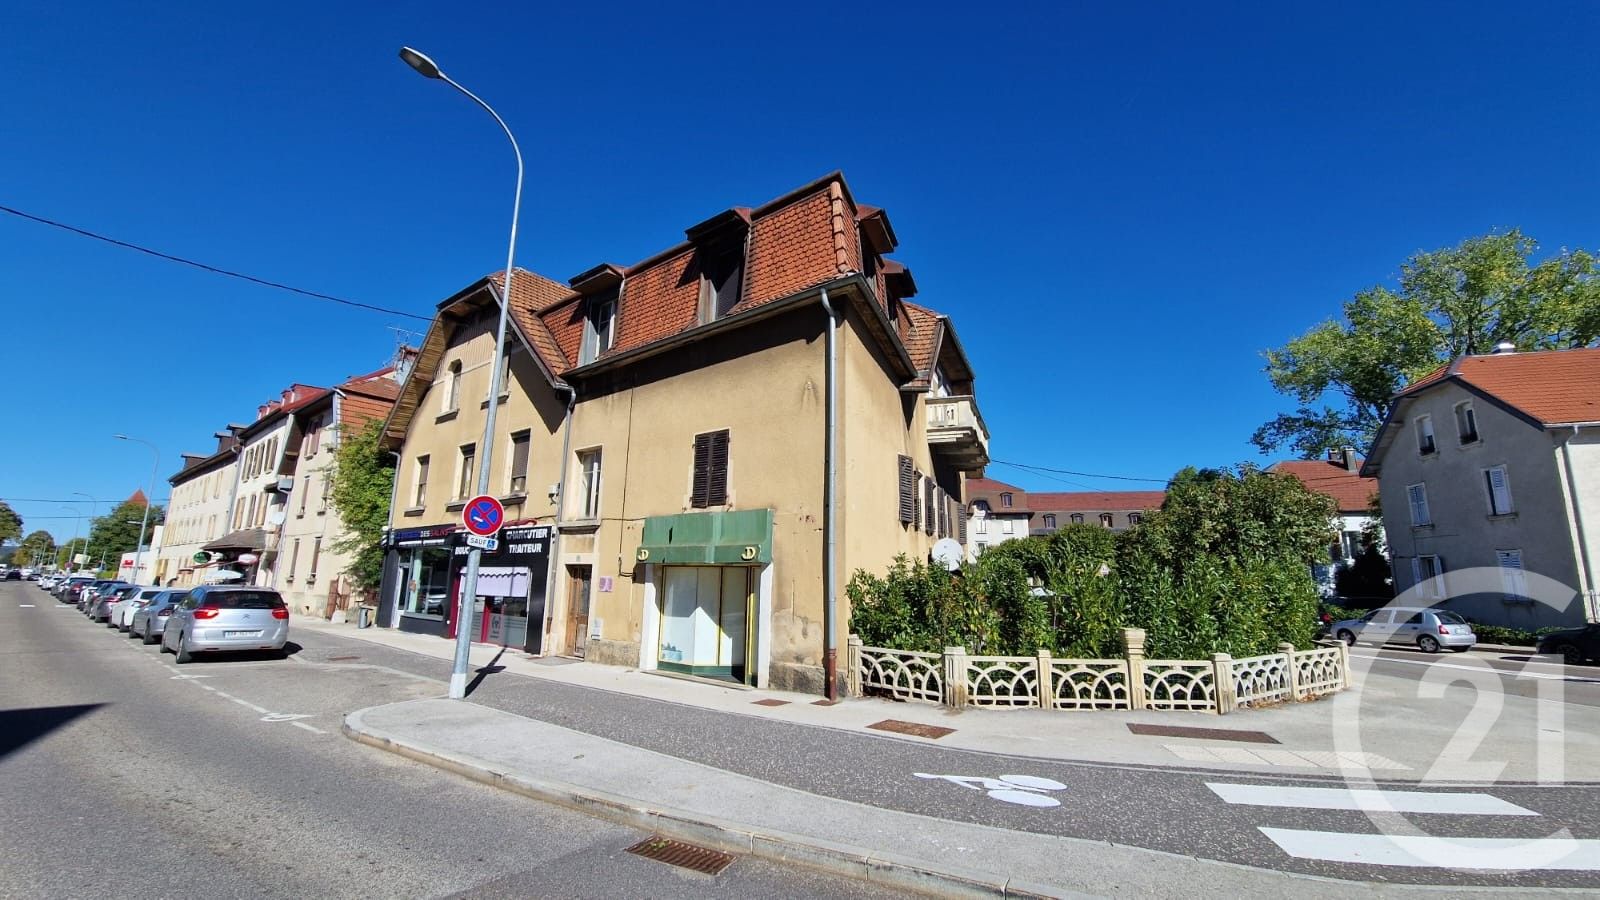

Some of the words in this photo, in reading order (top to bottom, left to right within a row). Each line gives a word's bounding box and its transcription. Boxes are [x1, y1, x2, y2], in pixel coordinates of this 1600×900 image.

[506, 528, 548, 540] CHARCUTIER
[470, 537, 487, 545] SAUF
[508, 543, 542, 553] TRAITEUR
